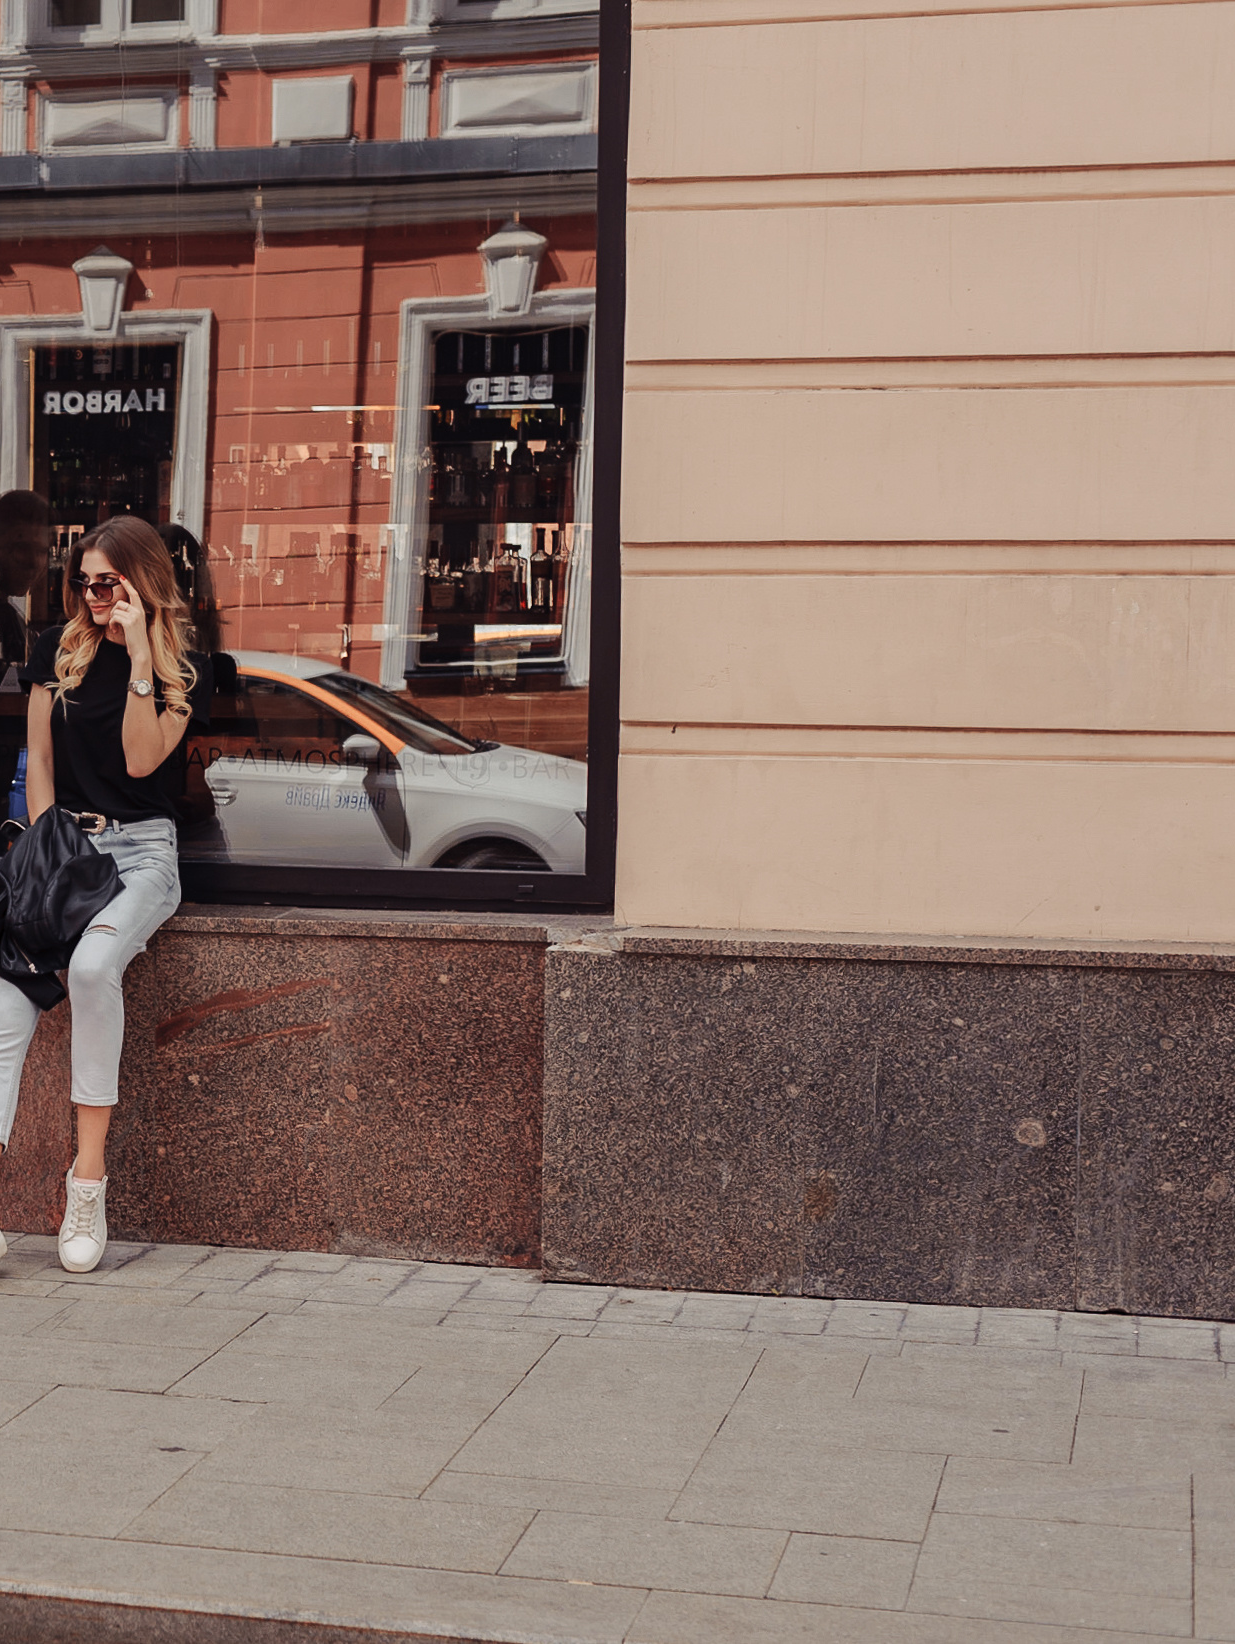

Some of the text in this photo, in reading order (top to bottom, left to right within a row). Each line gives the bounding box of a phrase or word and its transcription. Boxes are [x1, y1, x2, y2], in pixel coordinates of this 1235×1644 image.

[238, 748, 435, 777] ATMOSPHERE
[460, 754, 488, 780] 19
[513, 754, 571, 780] BAR
